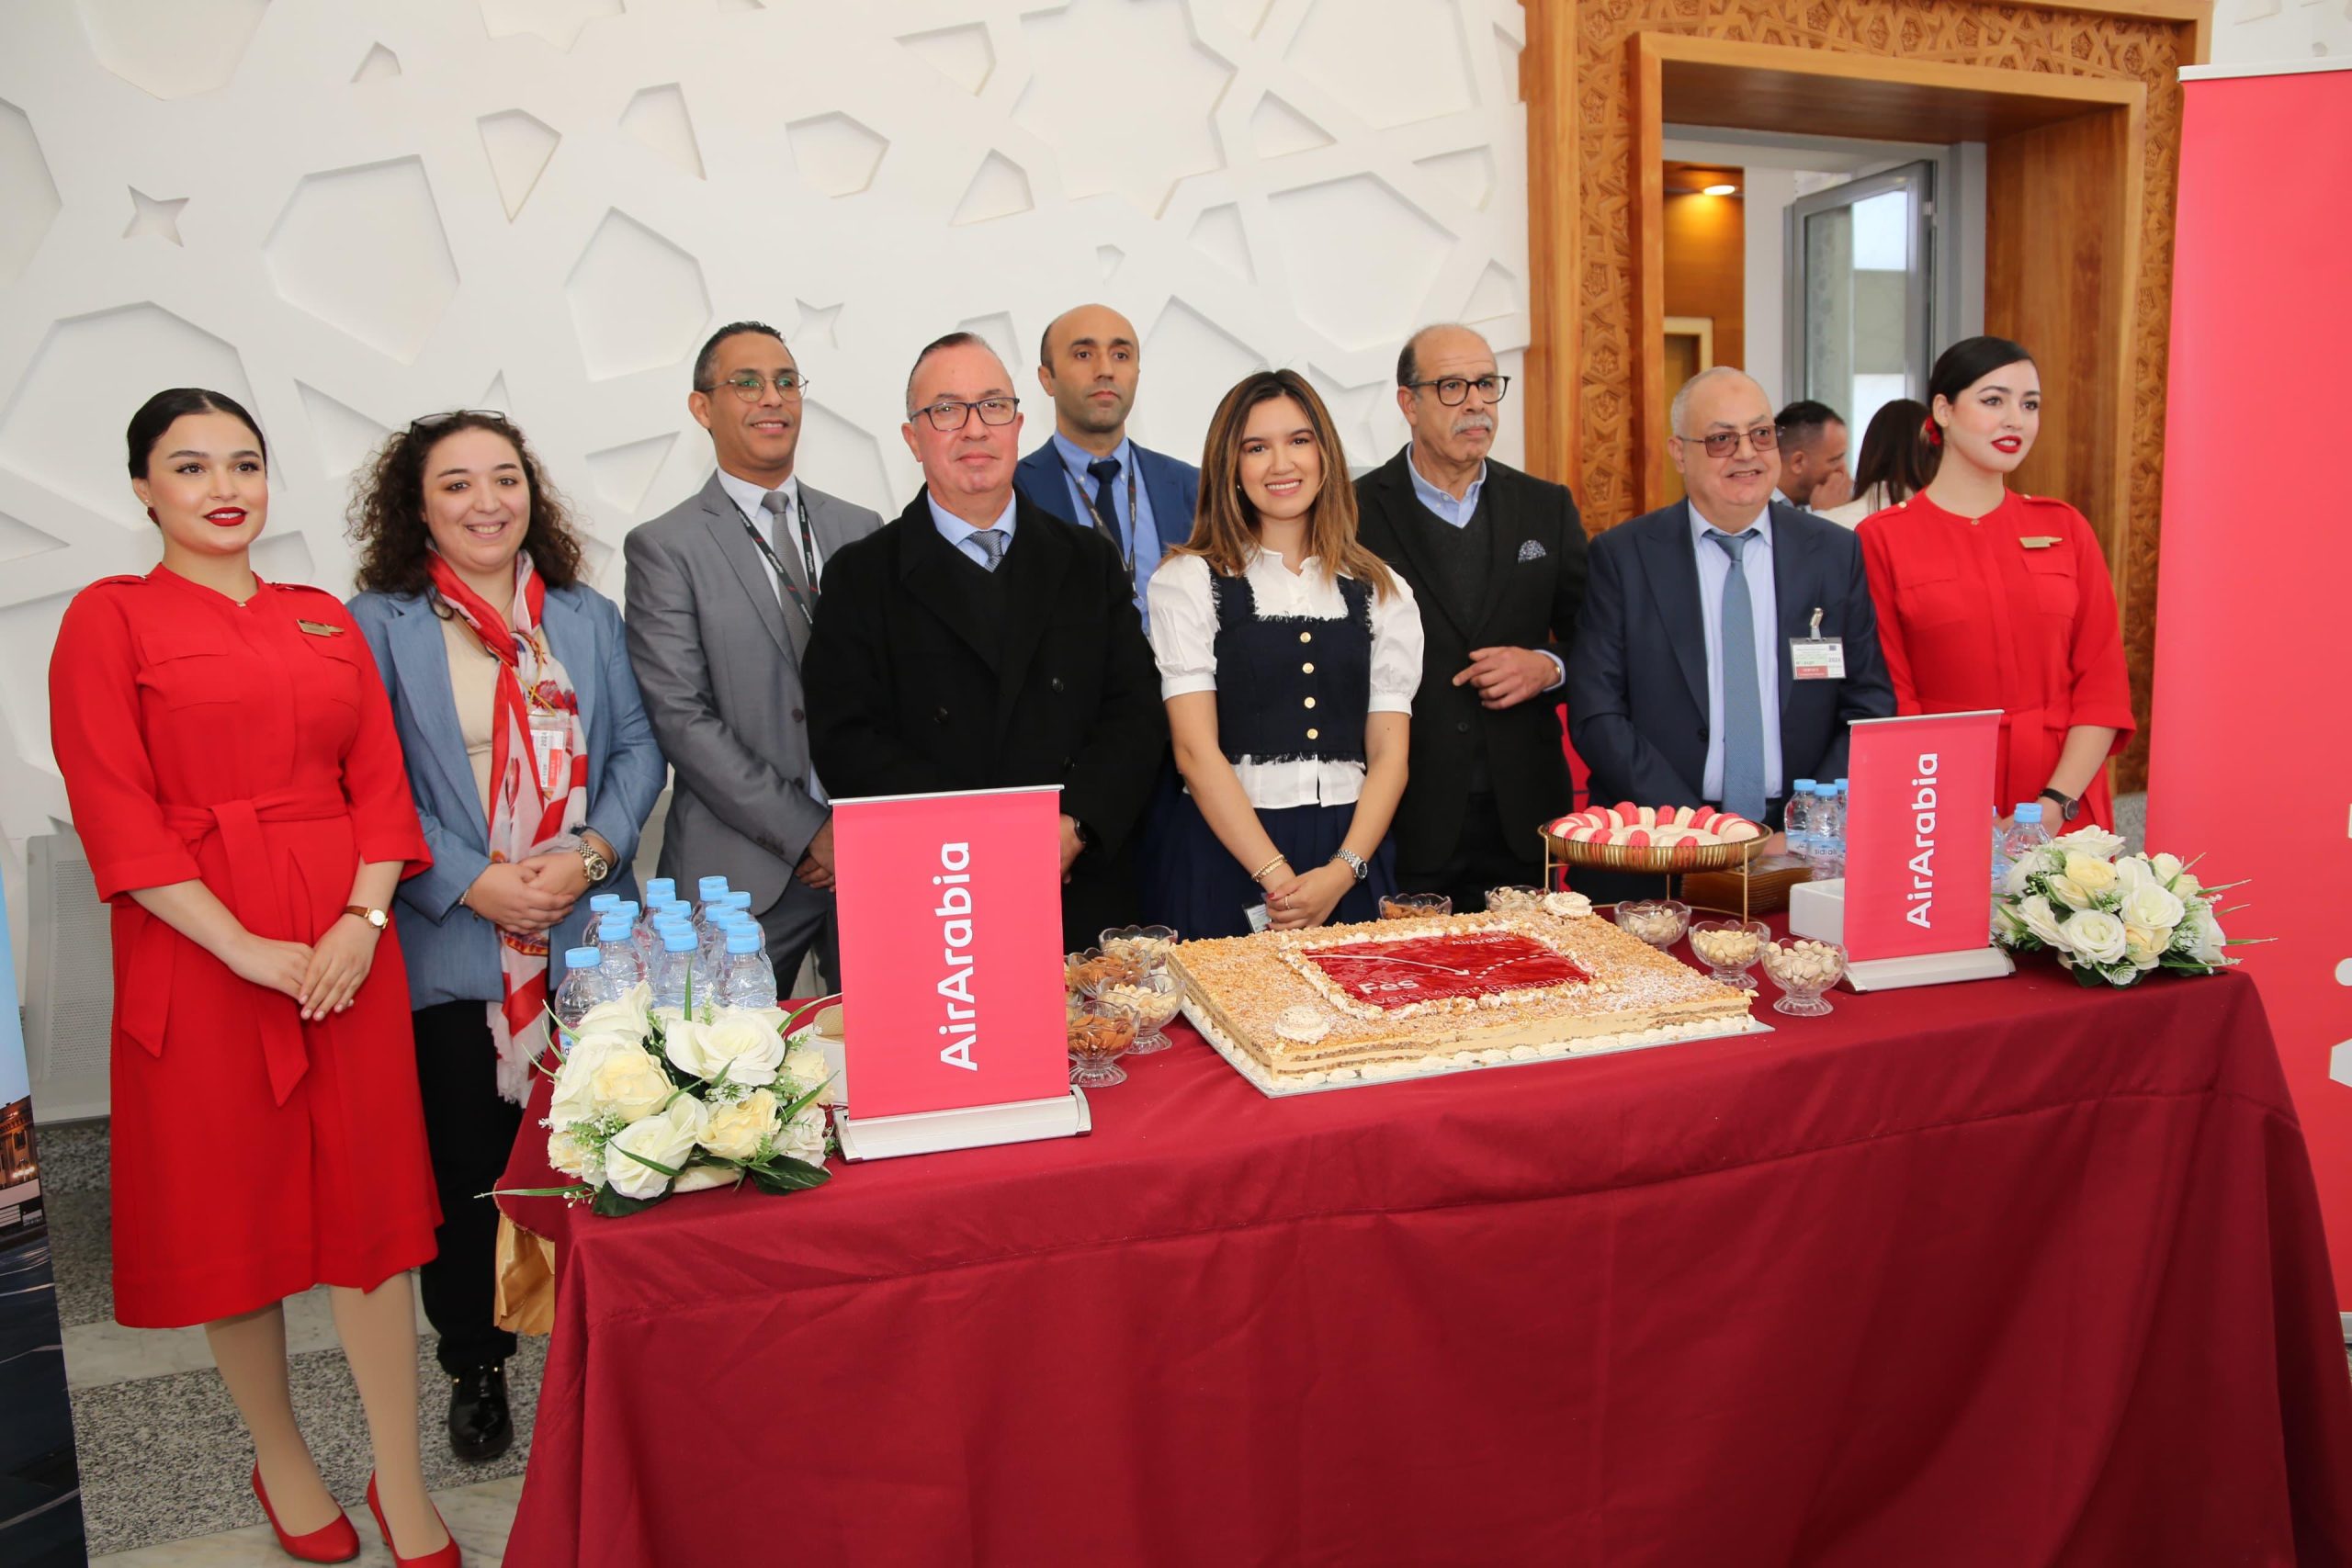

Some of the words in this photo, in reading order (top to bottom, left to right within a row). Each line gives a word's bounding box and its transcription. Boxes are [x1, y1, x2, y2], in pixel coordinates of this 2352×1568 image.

[1906, 753, 1938, 929] AirArabia
[933, 841, 978, 1071] AirArabia
[1451, 935, 1515, 946] AirArabia
[1372, 993, 1421, 1005] vers
